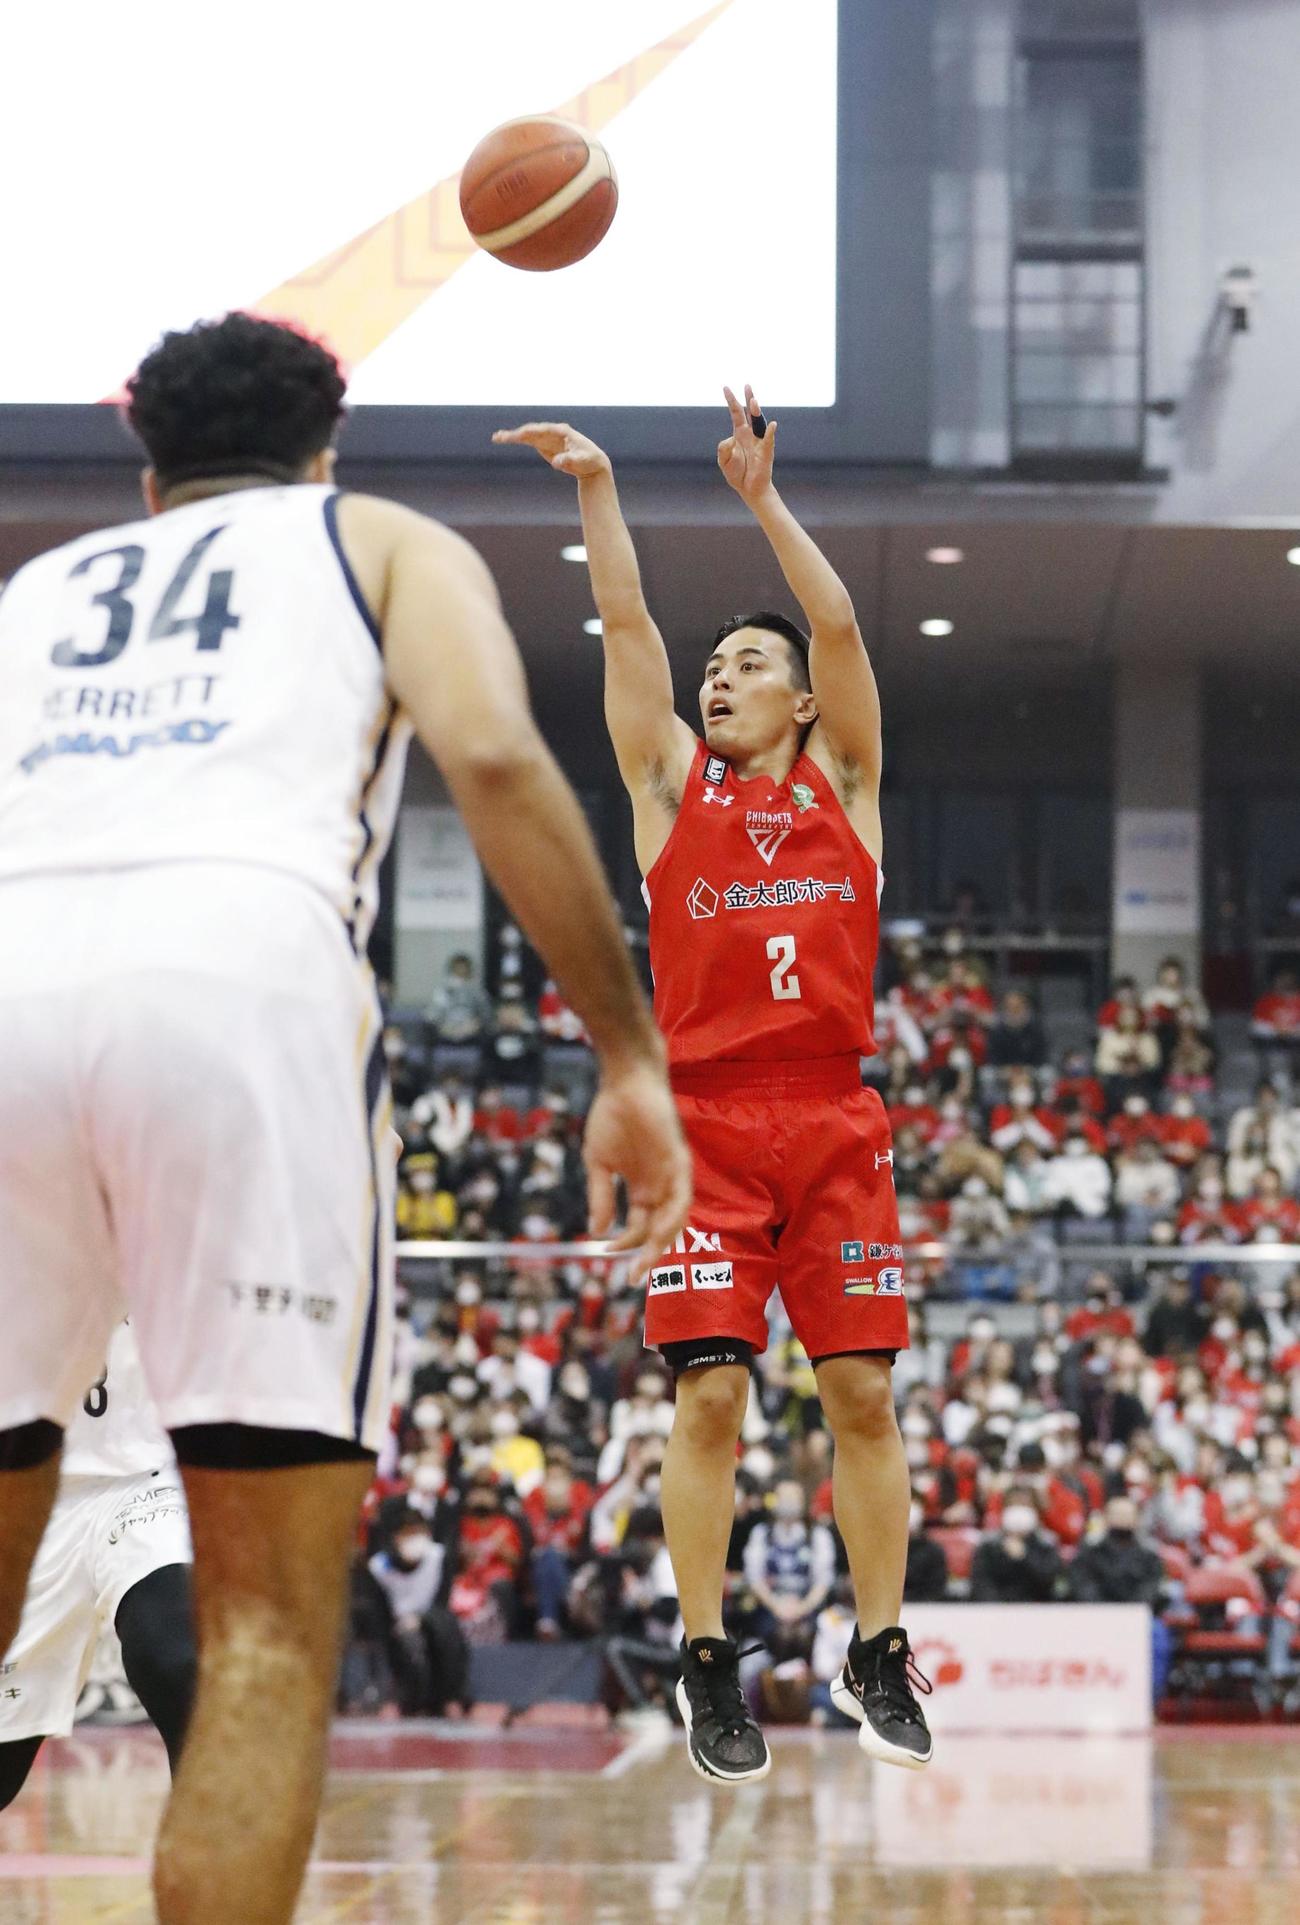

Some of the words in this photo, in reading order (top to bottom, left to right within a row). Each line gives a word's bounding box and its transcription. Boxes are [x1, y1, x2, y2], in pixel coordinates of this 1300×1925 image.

[50, 523, 240, 668] 34
[724, 877, 855, 909] 金太郎ホーム
[765, 935, 801, 1000] 2
